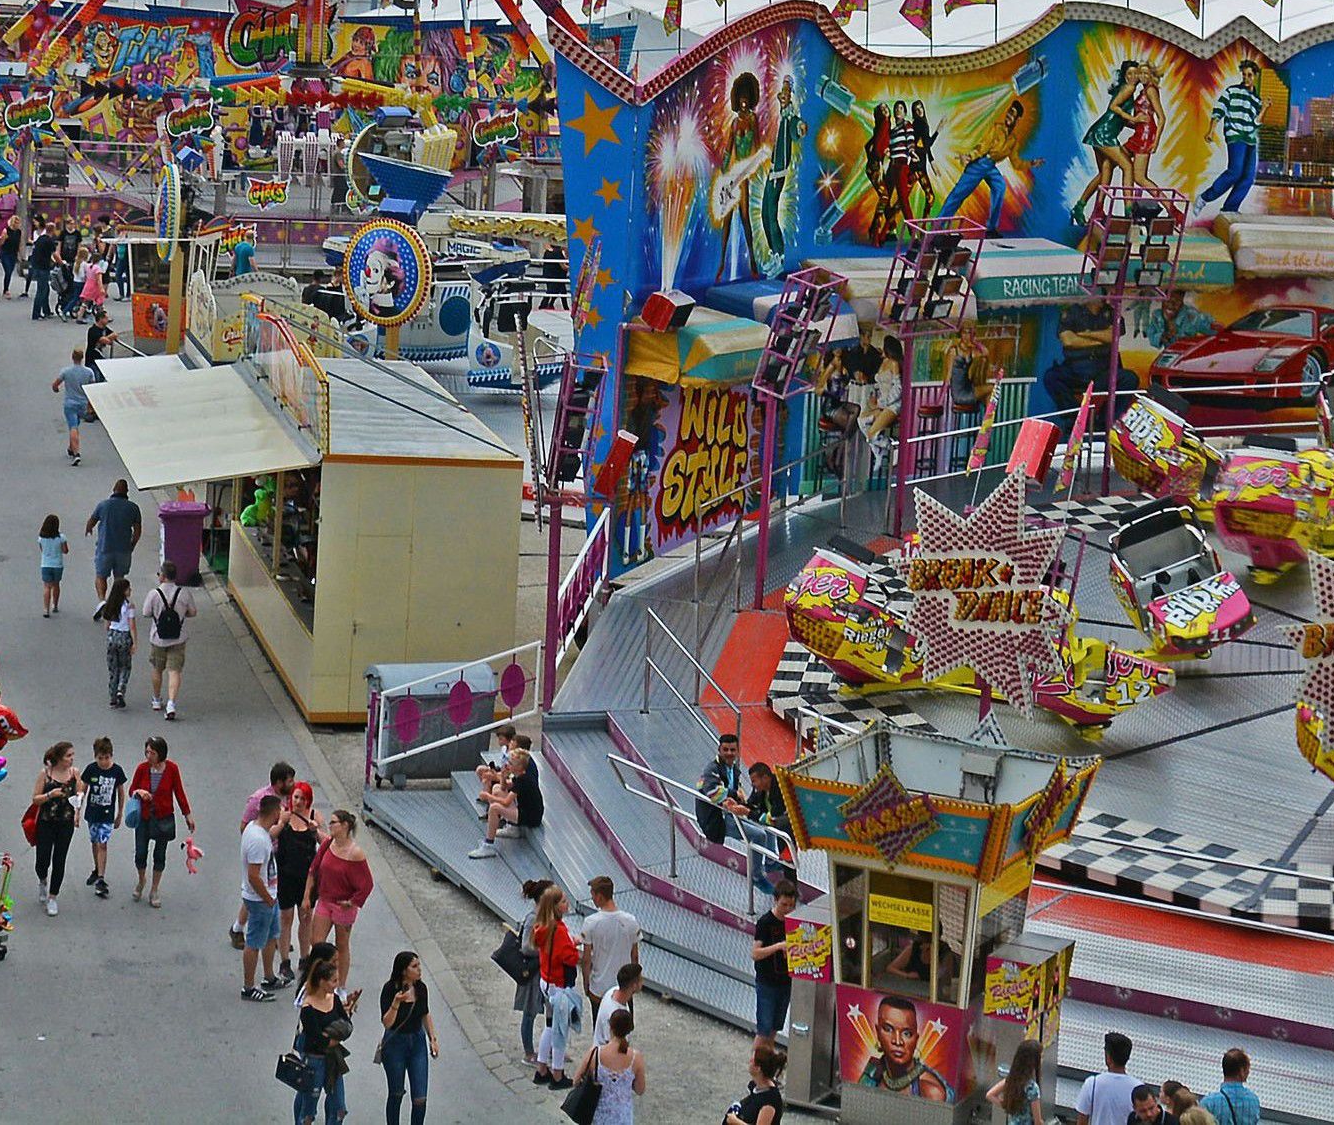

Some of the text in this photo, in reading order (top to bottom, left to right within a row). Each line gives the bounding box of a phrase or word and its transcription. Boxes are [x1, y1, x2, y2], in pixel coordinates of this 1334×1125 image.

[448, 240, 482, 255] MAGIC
[1003, 279, 1052, 297] RACING
[681, 387, 747, 448] WILD
[661, 444, 747, 521] STYLE
[912, 558, 1000, 591] BREAK
[954, 590, 1044, 623] DANCE
[1164, 578, 1220, 629] RIDE
[1210, 628, 1232, 642] 11
[1116, 681, 1151, 706] 12
[844, 796, 934, 844] KASSE
[871, 900, 931, 918] WECHSELKASSE
